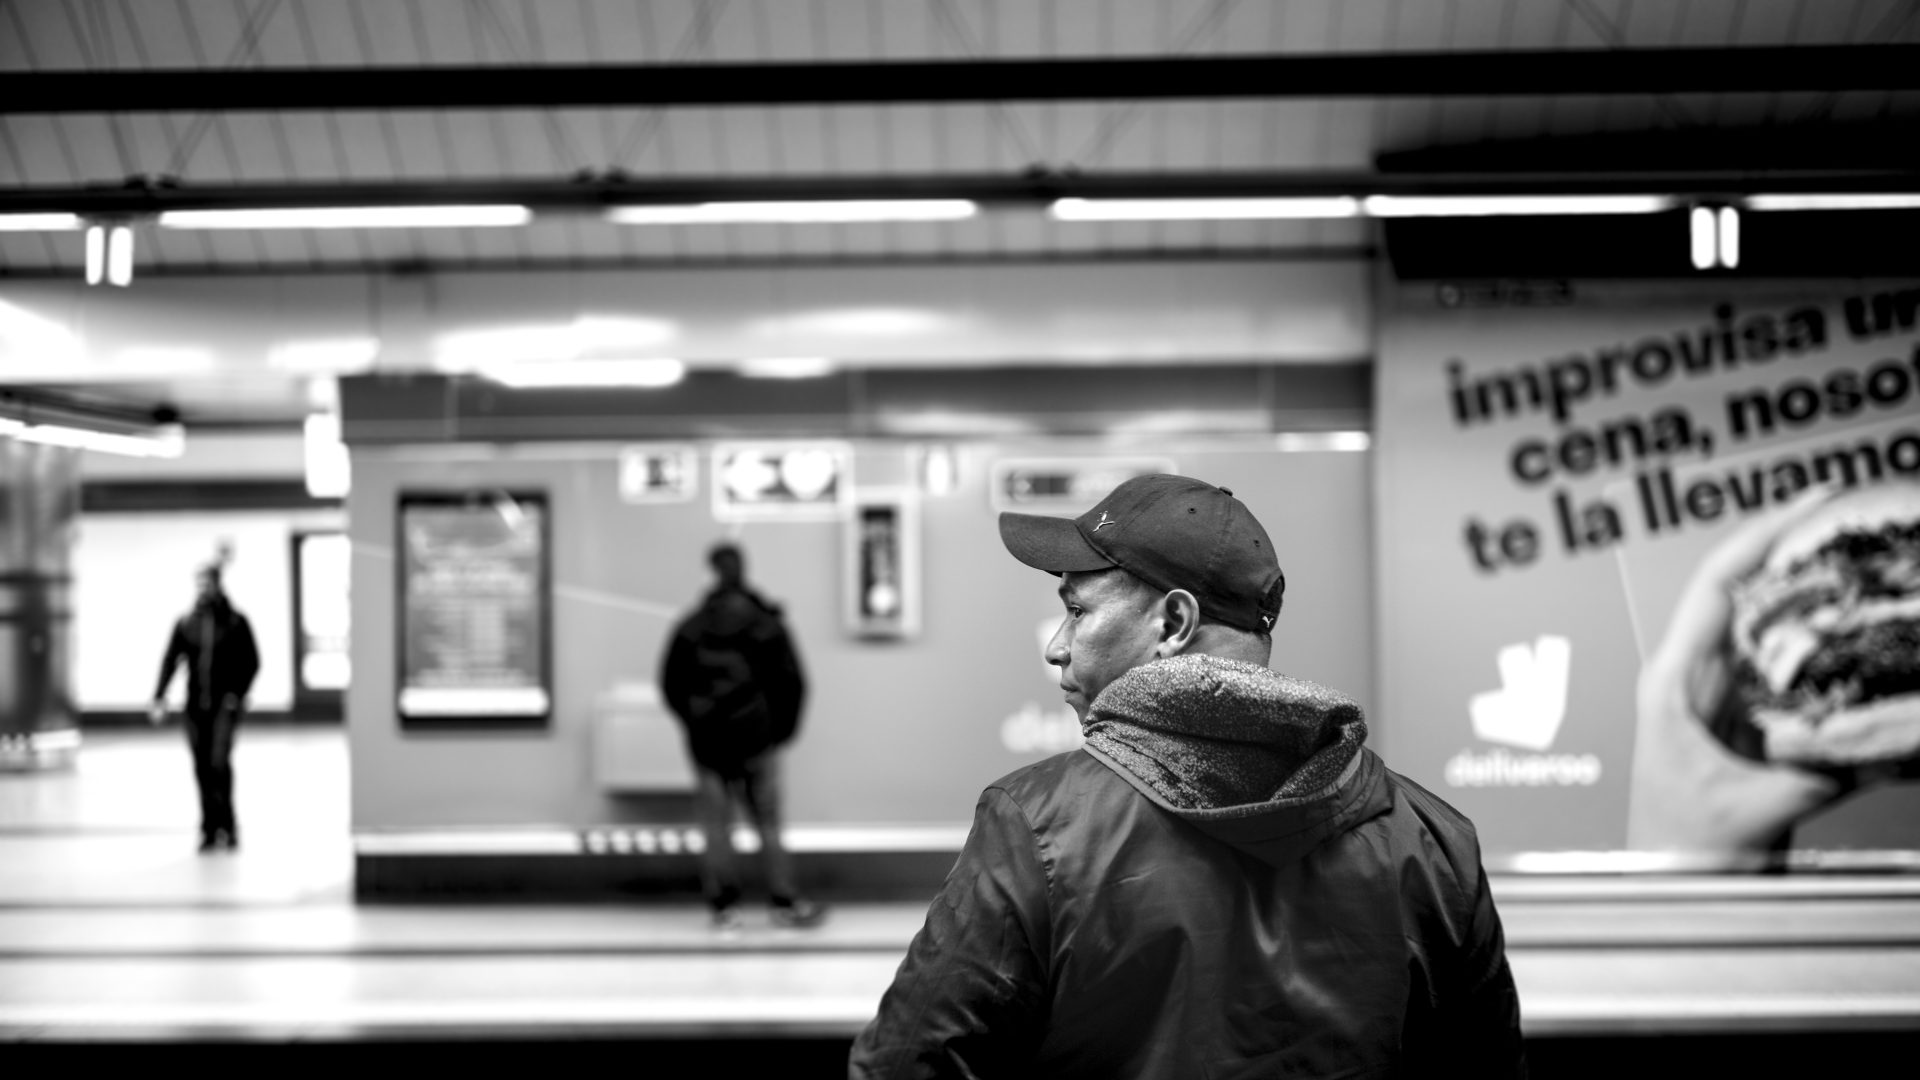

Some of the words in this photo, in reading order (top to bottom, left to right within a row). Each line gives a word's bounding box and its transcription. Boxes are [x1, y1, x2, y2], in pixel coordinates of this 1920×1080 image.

[1447, 303, 1827, 424] improvisa
[1511, 408, 1713, 483] cena,
[1727, 345, 1920, 437] noso
[1465, 518, 1539, 570] te
[1555, 490, 1623, 551] la
